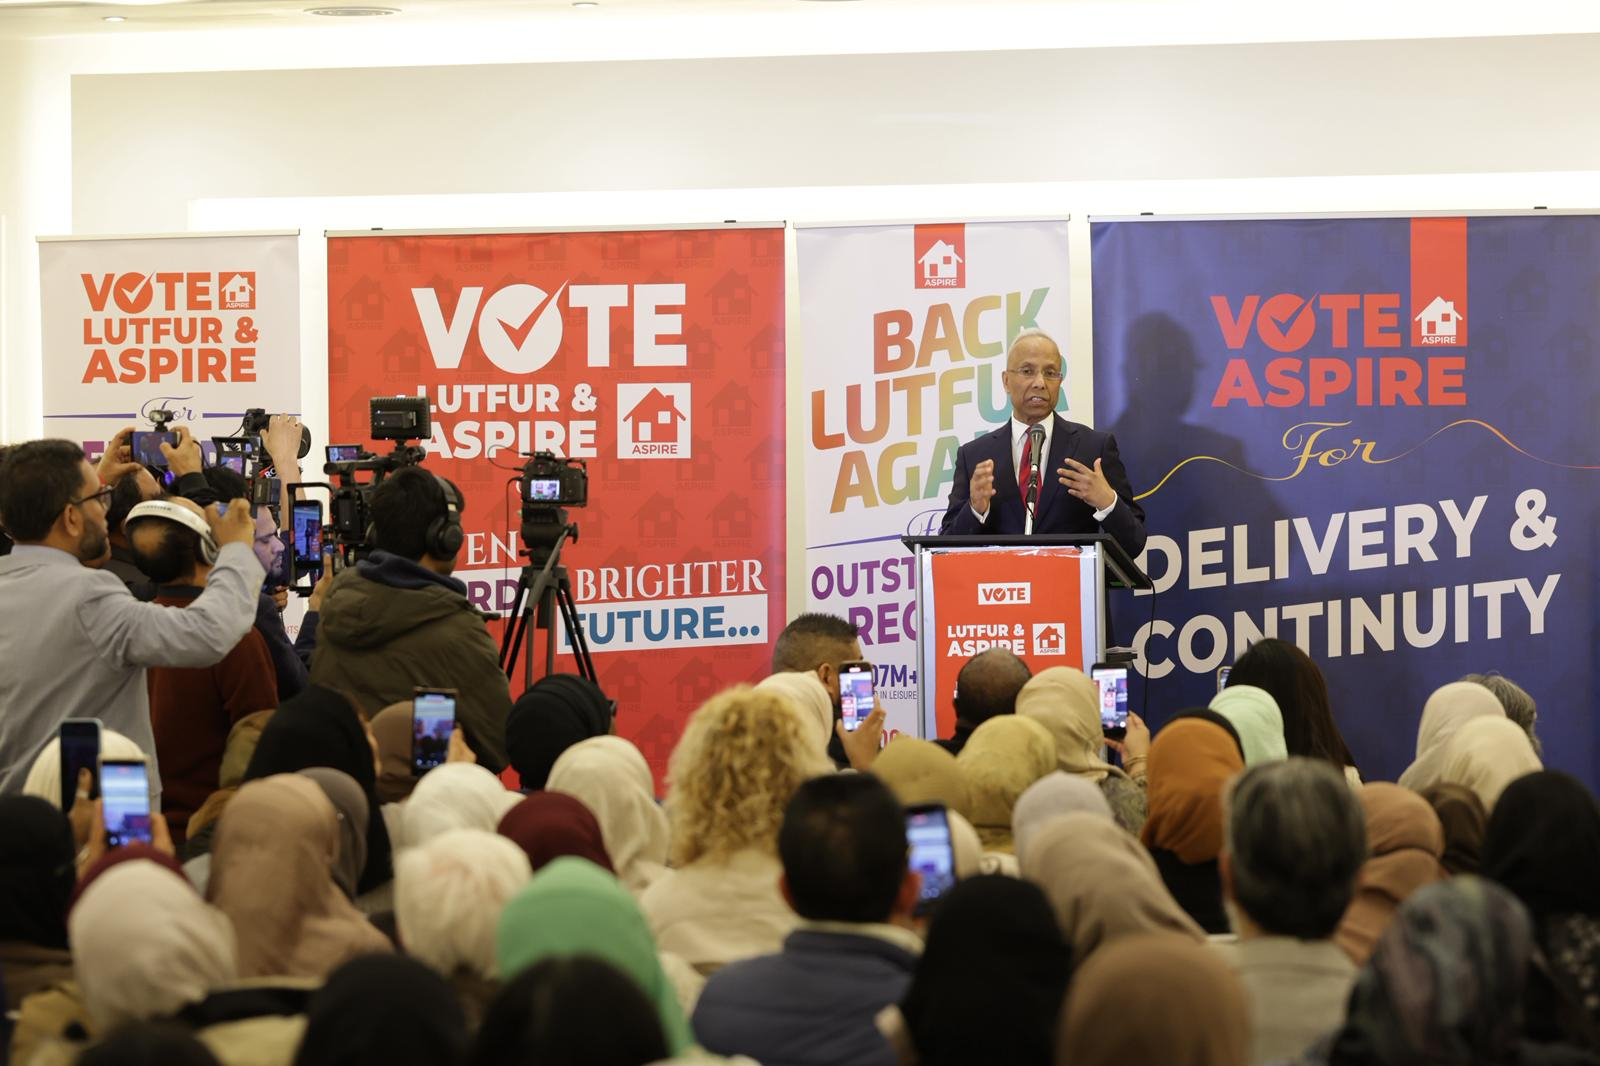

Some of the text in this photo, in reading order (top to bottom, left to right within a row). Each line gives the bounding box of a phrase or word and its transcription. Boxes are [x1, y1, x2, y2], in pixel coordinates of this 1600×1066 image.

[81, 271, 212, 314] VOTE
[925, 278, 957, 286] ASPIRE
[83, 316, 258, 345] LUTFUR &
[411, 279, 687, 374] VOTE
[874, 287, 1050, 374] BACK
[1209, 292, 1401, 352] VOTE
[1421, 336, 1457, 344] ASPIRE
[81, 347, 257, 384] ASPIRE
[1211, 357, 1467, 408] ASPIRE
[571, 383, 597, 412] &
[812, 355, 1069, 450] LUTFU
[420, 420, 597, 459] ASPIRE
[632, 444, 678, 455] ASPIRE
[1278, 420, 1388, 480] For
[1133, 488, 1558, 596] DELIVERY &
[576, 559, 767, 601] BRIGHTER
[982, 587, 1026, 602] VOTE
[947, 623, 1024, 638] LUTFUR &
[1131, 574, 1562, 679] CONTINUITY
[947, 639, 1026, 657] ASPIRE
[880, 691, 887, 699] IN
